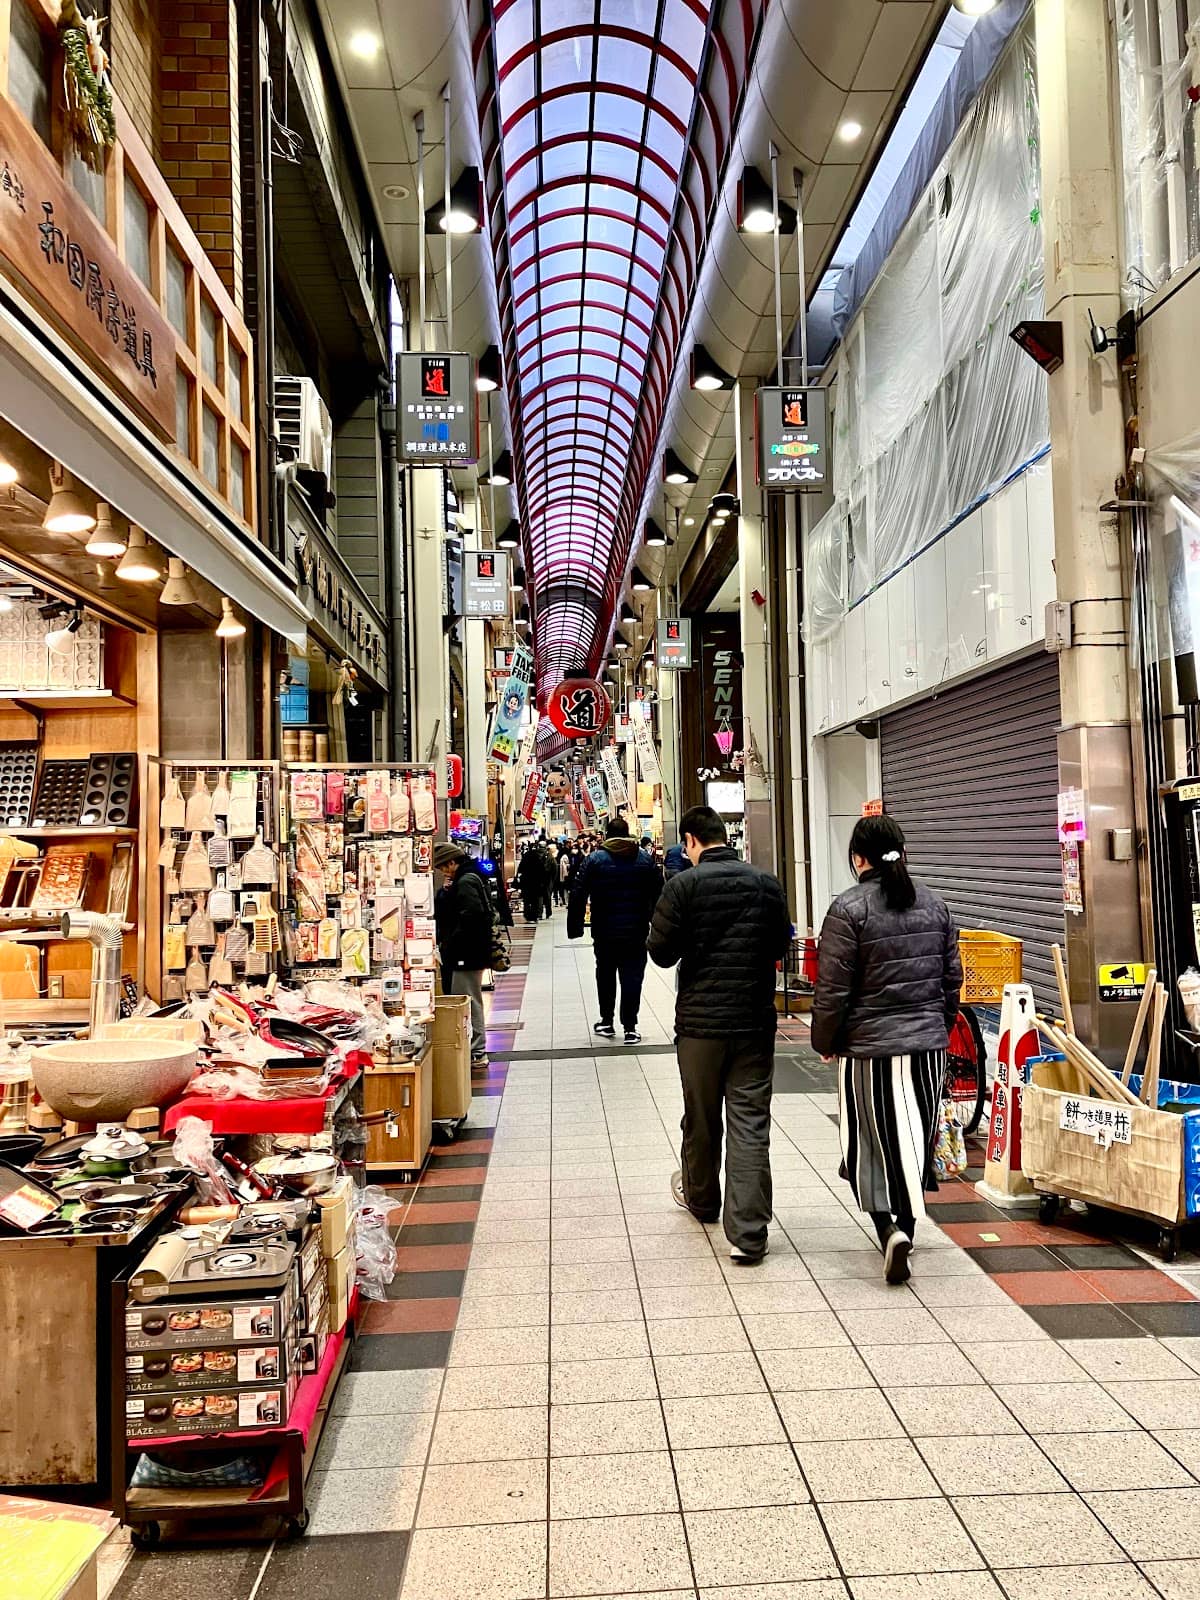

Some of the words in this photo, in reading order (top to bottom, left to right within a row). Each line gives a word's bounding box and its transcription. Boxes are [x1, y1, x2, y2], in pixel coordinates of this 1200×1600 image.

[480, 600, 505, 612] 松田
[560, 688, 601, 731] 道
[126, 1427, 154, 1437] BLAZE
